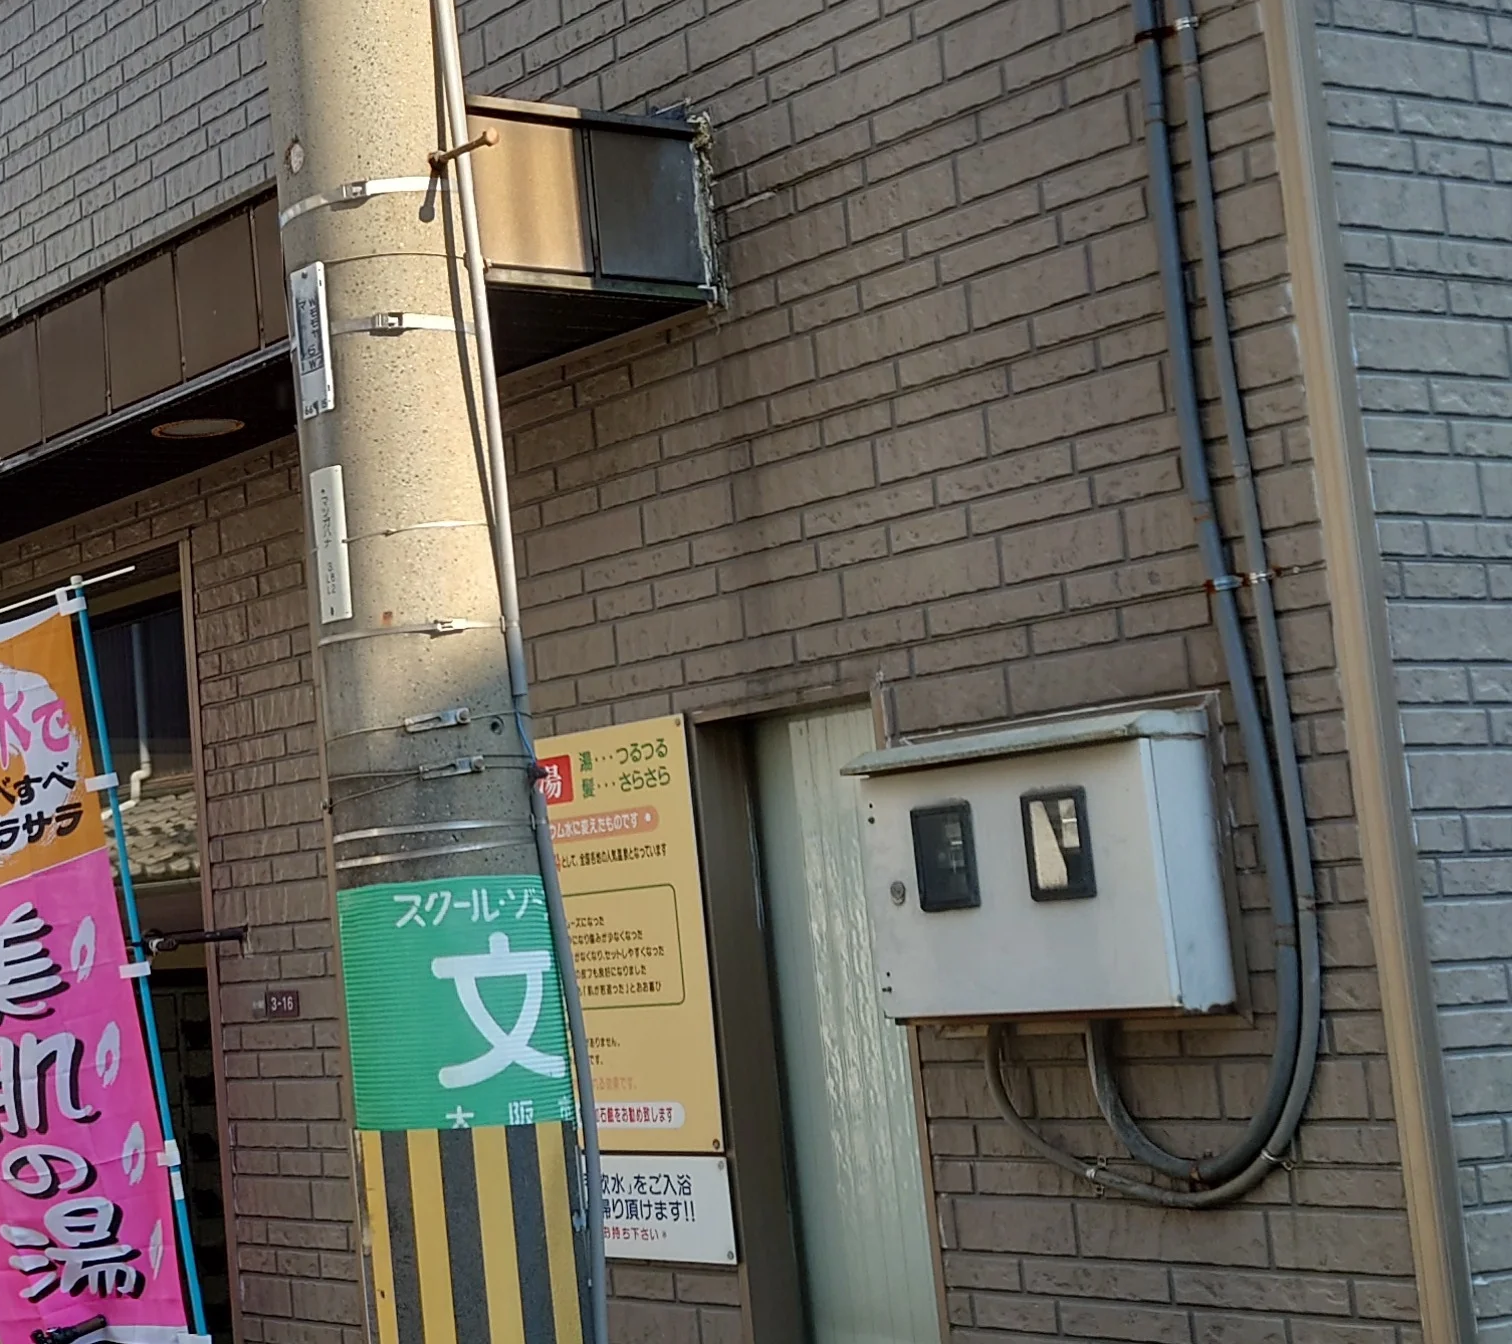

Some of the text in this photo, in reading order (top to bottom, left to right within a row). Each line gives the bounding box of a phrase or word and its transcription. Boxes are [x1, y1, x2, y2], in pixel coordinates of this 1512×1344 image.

[567, 916, 605, 929] ーズになった
[431, 932, 566, 1089] 文
